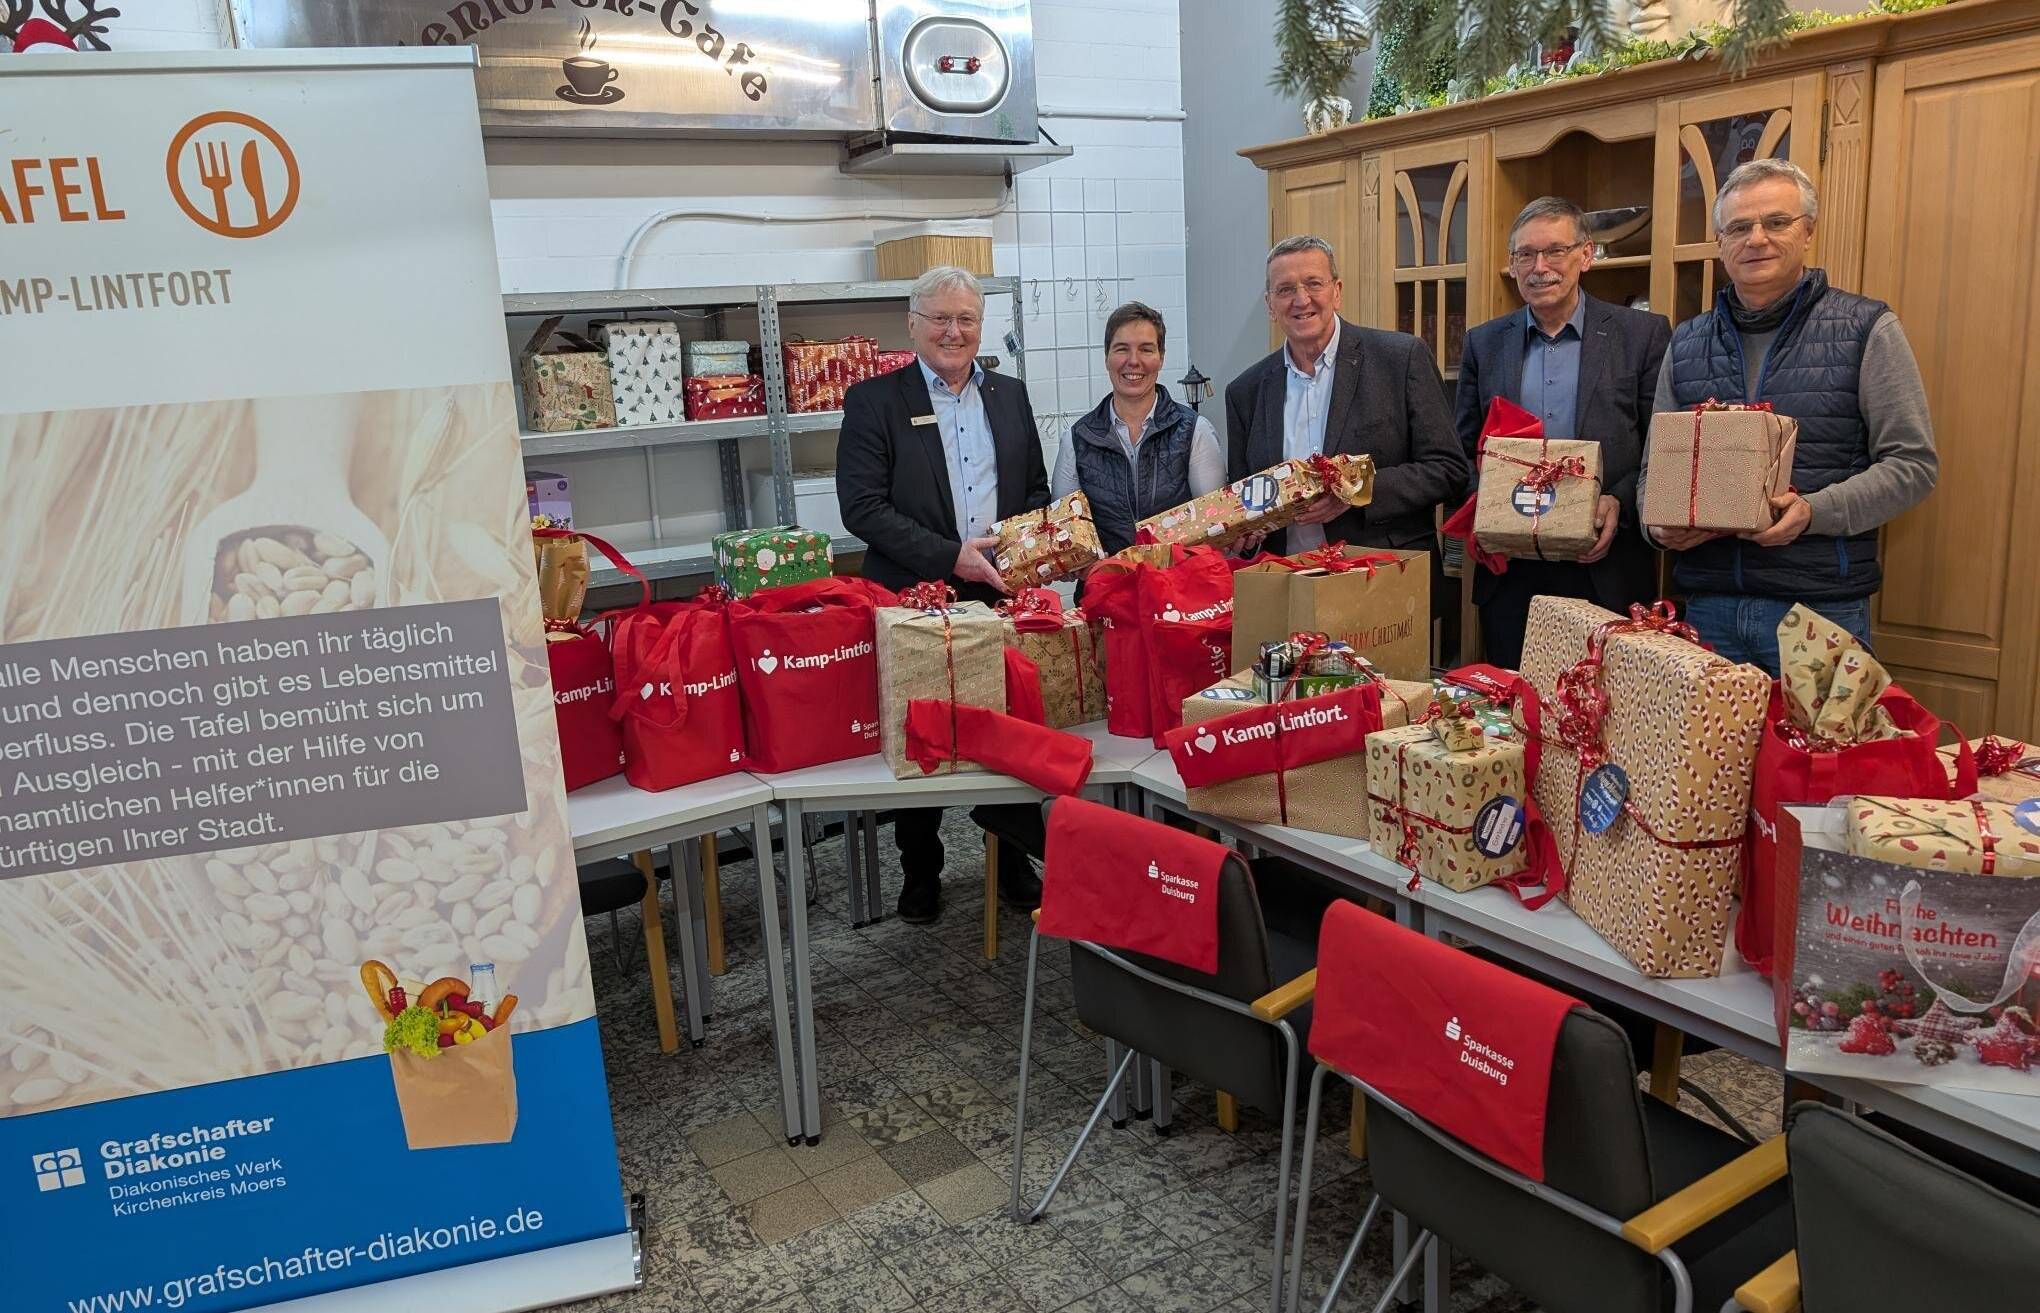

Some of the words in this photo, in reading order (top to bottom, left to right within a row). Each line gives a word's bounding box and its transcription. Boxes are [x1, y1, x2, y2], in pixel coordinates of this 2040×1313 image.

[0, 268, 232, 315] MP-LINTFORT
[51, 649, 208, 682] Menschen
[217, 638, 309, 665] haben
[317, 631, 352, 655] ihr
[361, 621, 454, 653] täglich
[751, 656, 756, 672] I
[2, 695, 62, 724] und
[72, 681, 204, 716] dennoch
[213, 674, 270, 706] gibt
[278, 674, 312, 693] es
[320, 650, 498, 690] Lebensmittel
[0, 732, 116, 760] erfluss.
[125, 720, 175, 746] Die
[180, 710, 251, 740] Tafel
[259, 699, 370, 731] bemüht
[377, 692, 433, 718] sich
[441, 690, 484, 712] um
[13, 757, 161, 796] Ausgleich
[193, 748, 239, 774] mit
[247, 743, 295, 767] der
[303, 734, 366, 760] Hilfe
[374, 729, 425, 752] von
[1184, 741, 1194, 757] I
[352, 764, 390, 788] für
[399, 759, 440, 784] die
[123, 826, 189, 851] Ihrer
[197, 812, 285, 842] Stadt.
[1160, 871, 1199, 890] Sparkasse
[1161, 884, 1195, 904] Duisburg
[1460, 1050, 1508, 1086] Duisburg
[1463, 1034, 1515, 1070] Sparkasse
[100, 1116, 275, 1160] Grafschafter
[104, 1145, 227, 1180] Diakonie
[109, 1167, 231, 1200] Diakonisches
[235, 1157, 282, 1177] Werk
[113, 1184, 226, 1217] Kirchenkreis
[230, 1175, 287, 1197] Moers
[67, 1207, 544, 1313] www.grafschafter-diakonie.de
